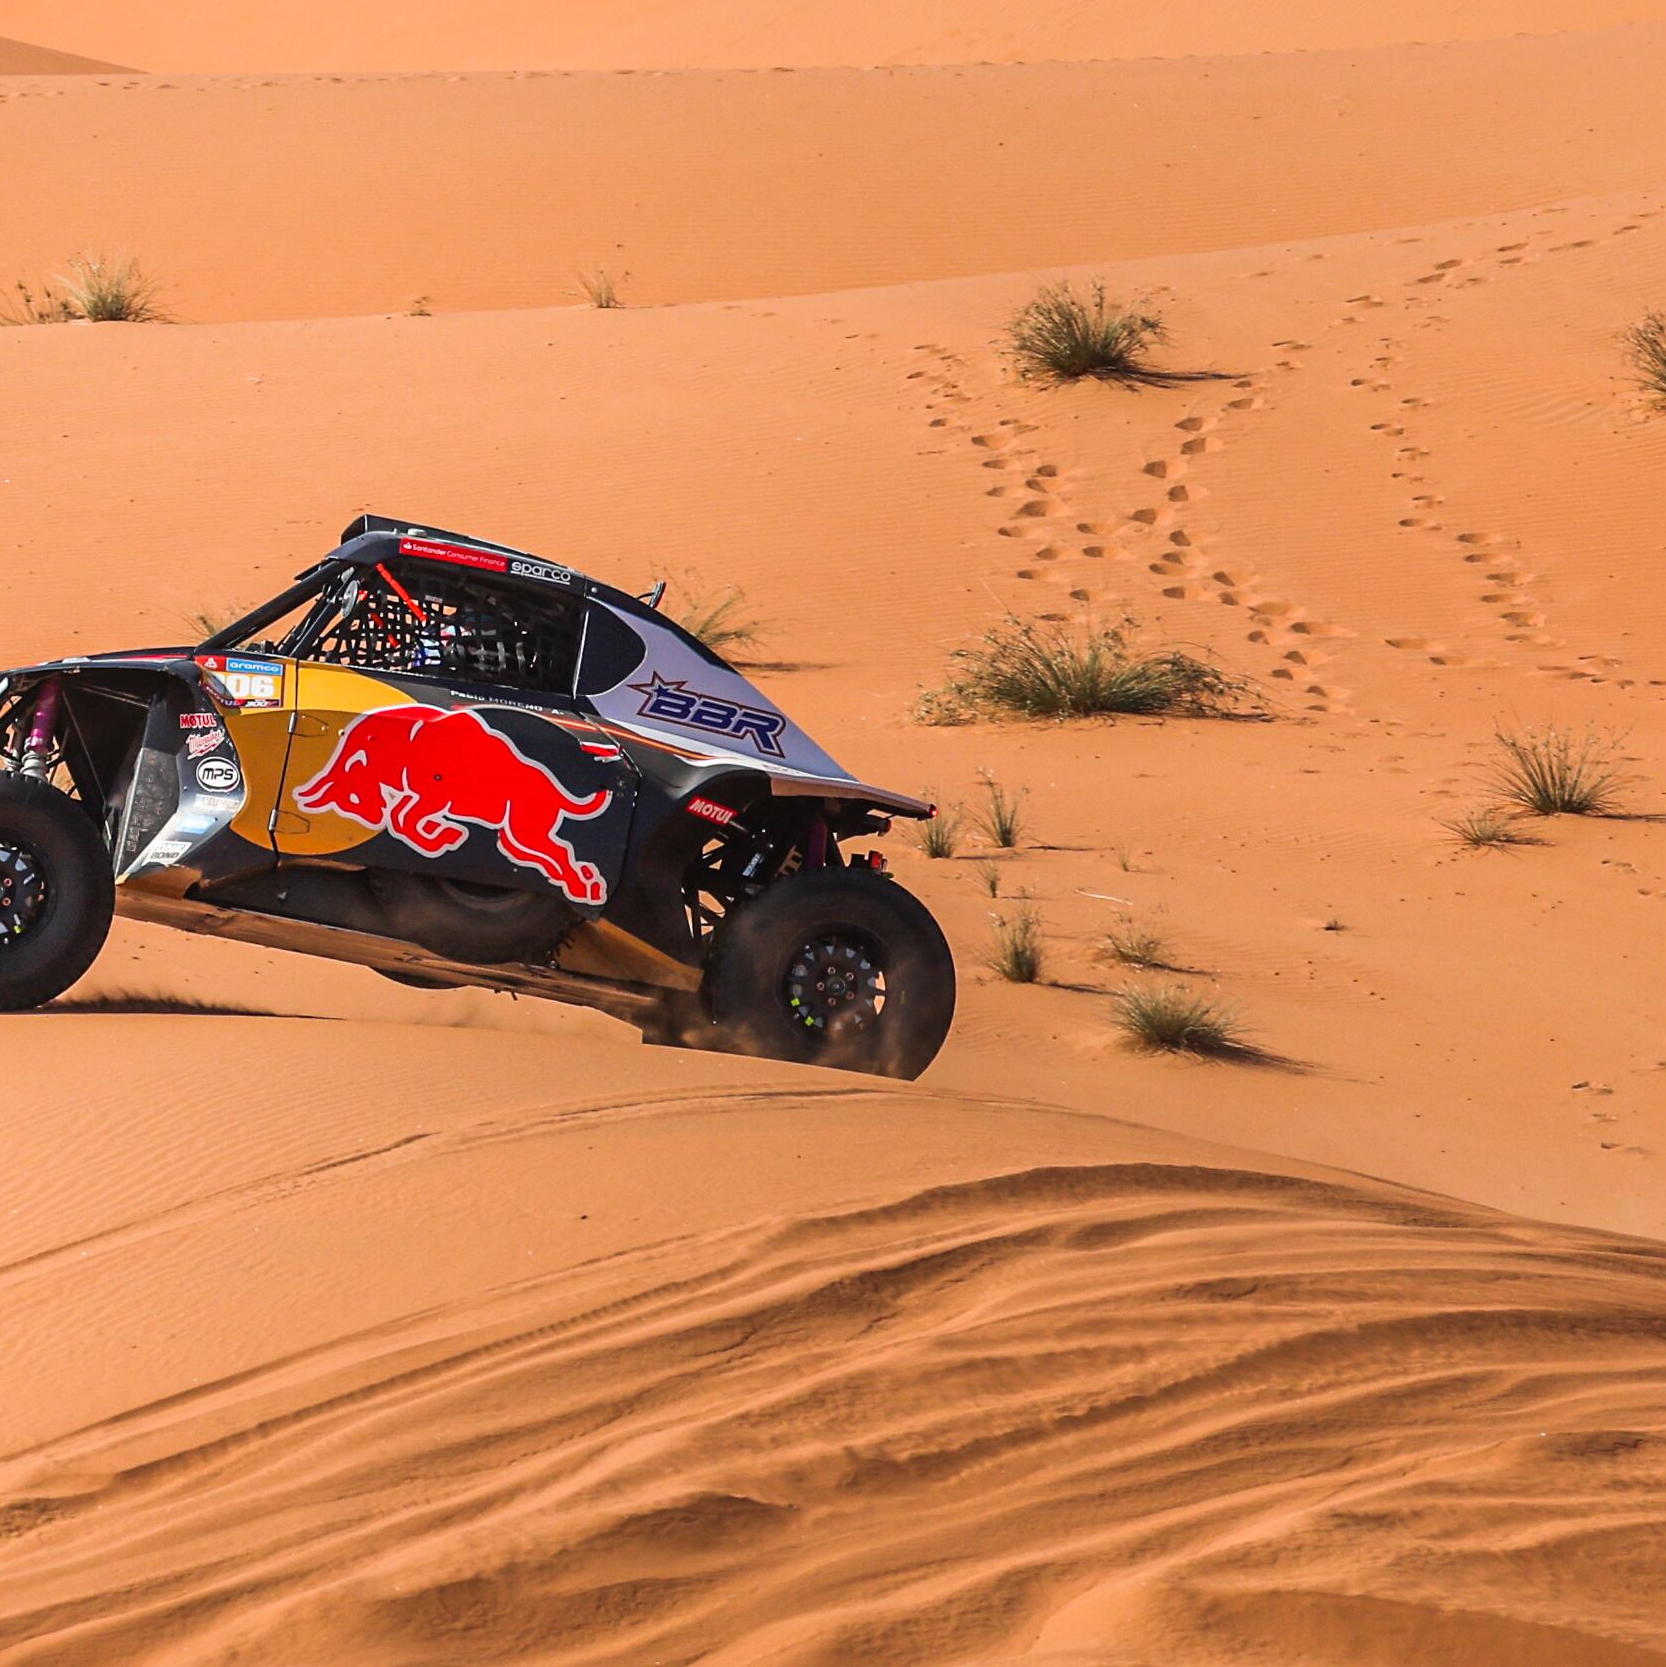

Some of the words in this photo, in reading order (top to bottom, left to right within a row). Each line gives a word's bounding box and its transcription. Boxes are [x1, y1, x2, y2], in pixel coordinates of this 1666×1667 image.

[412, 543, 446, 556] Santander
[446, 549, 479, 563] Consumer
[479, 555, 505, 567] Finance
[511, 561, 571, 583] sparco
[229, 661, 279, 672] aramco
[450, 690, 485, 701] Pablo
[488, 696, 543, 712] MORENO
[646, 689, 781, 751] BBR
[202, 767, 234, 780] MPS
